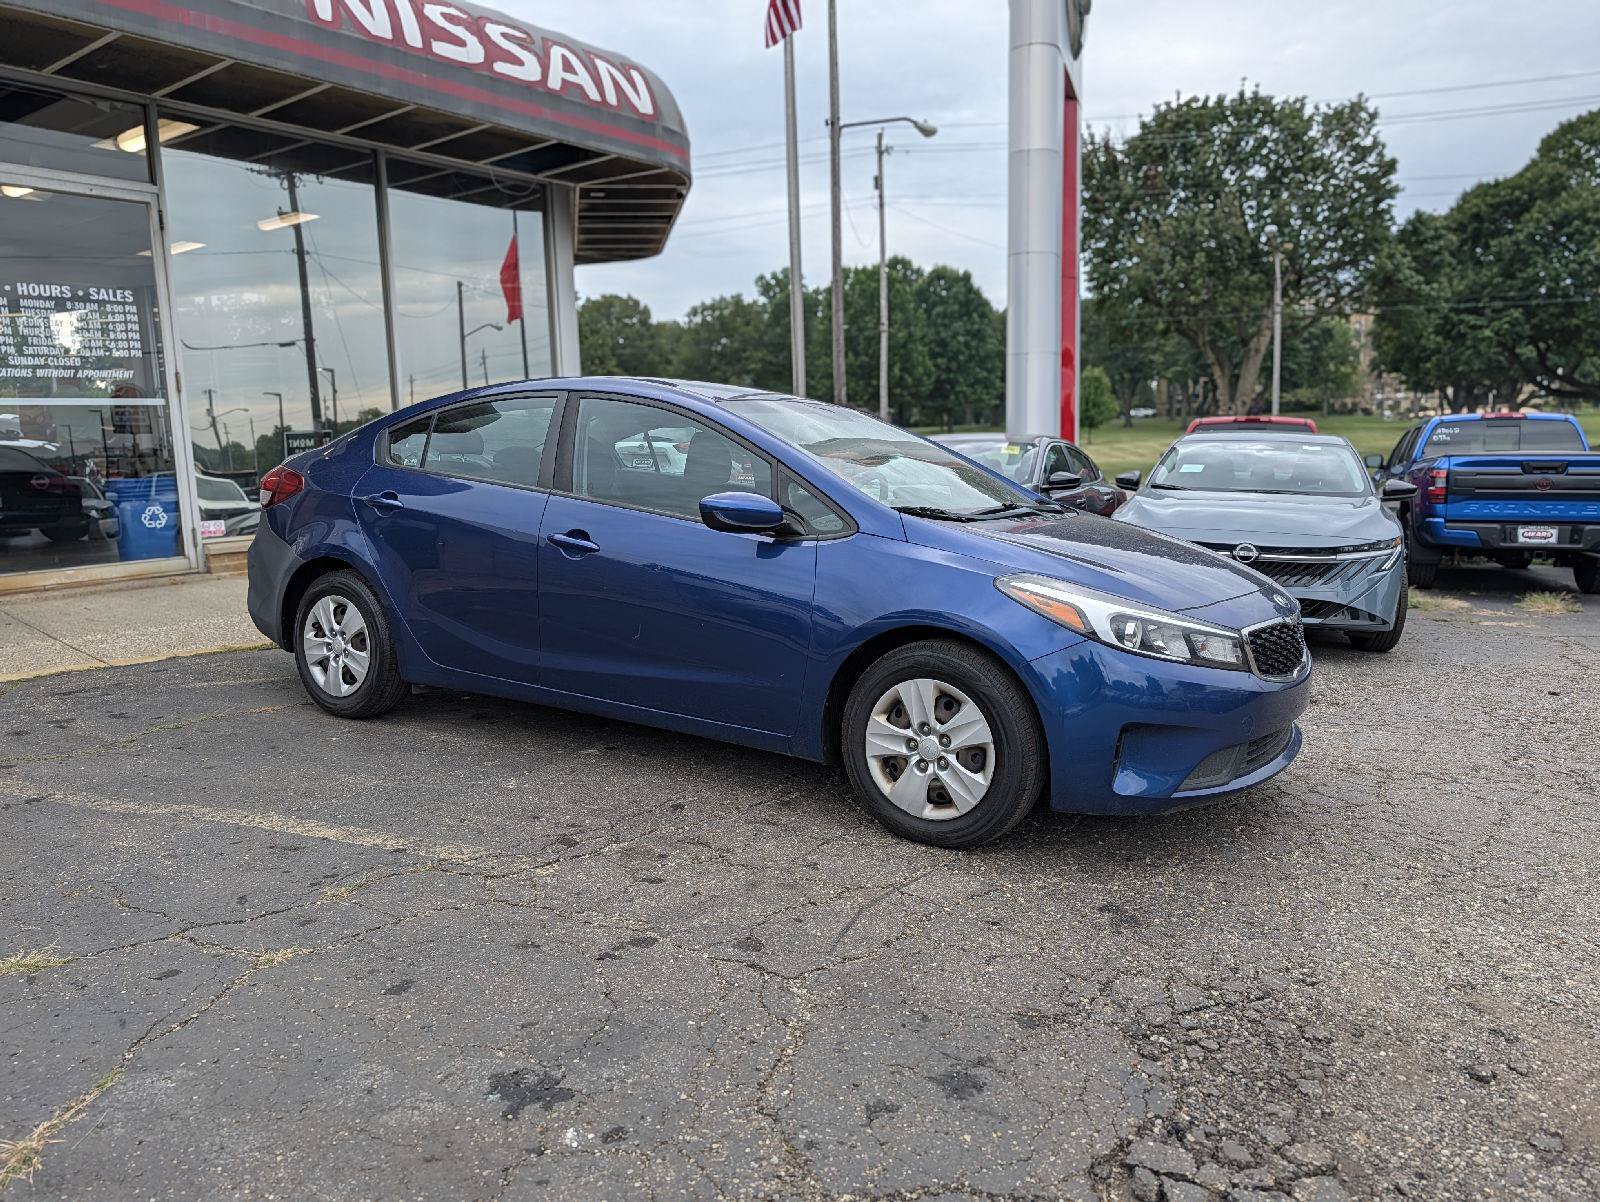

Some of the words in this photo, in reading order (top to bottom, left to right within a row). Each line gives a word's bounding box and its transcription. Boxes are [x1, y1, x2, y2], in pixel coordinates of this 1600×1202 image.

[313, 0, 655, 116] NISSAN
[17, 282, 71, 298] HOURS
[89, 288, 134, 302] SALES
[20, 298, 55, 309] MONDAY
[66, 301, 84, 310] 8:30
[86, 302, 98, 310] AM
[125, 305, 137, 313] PM
[20, 308, 56, 318] TUESDAY
[87, 312, 99, 320] AM
[126, 314, 138, 322] PM
[15, 317, 63, 326] WEDNESDAY
[88, 321, 101, 329] AM
[18, 326, 60, 336] THURSDAY
[0, 336, 13, 344] PM
[1, 345, 15, 355] PM
[23, 346, 64, 356] SATURDAY
[8, 356, 45, 365] SUNDAY
[48, 357, 81, 366] CLOSED
[0, 368, 32, 378] ATIONS
[36, 369, 76, 378] WITHOUT
[77, 370, 134, 379] APPOINTMENT
